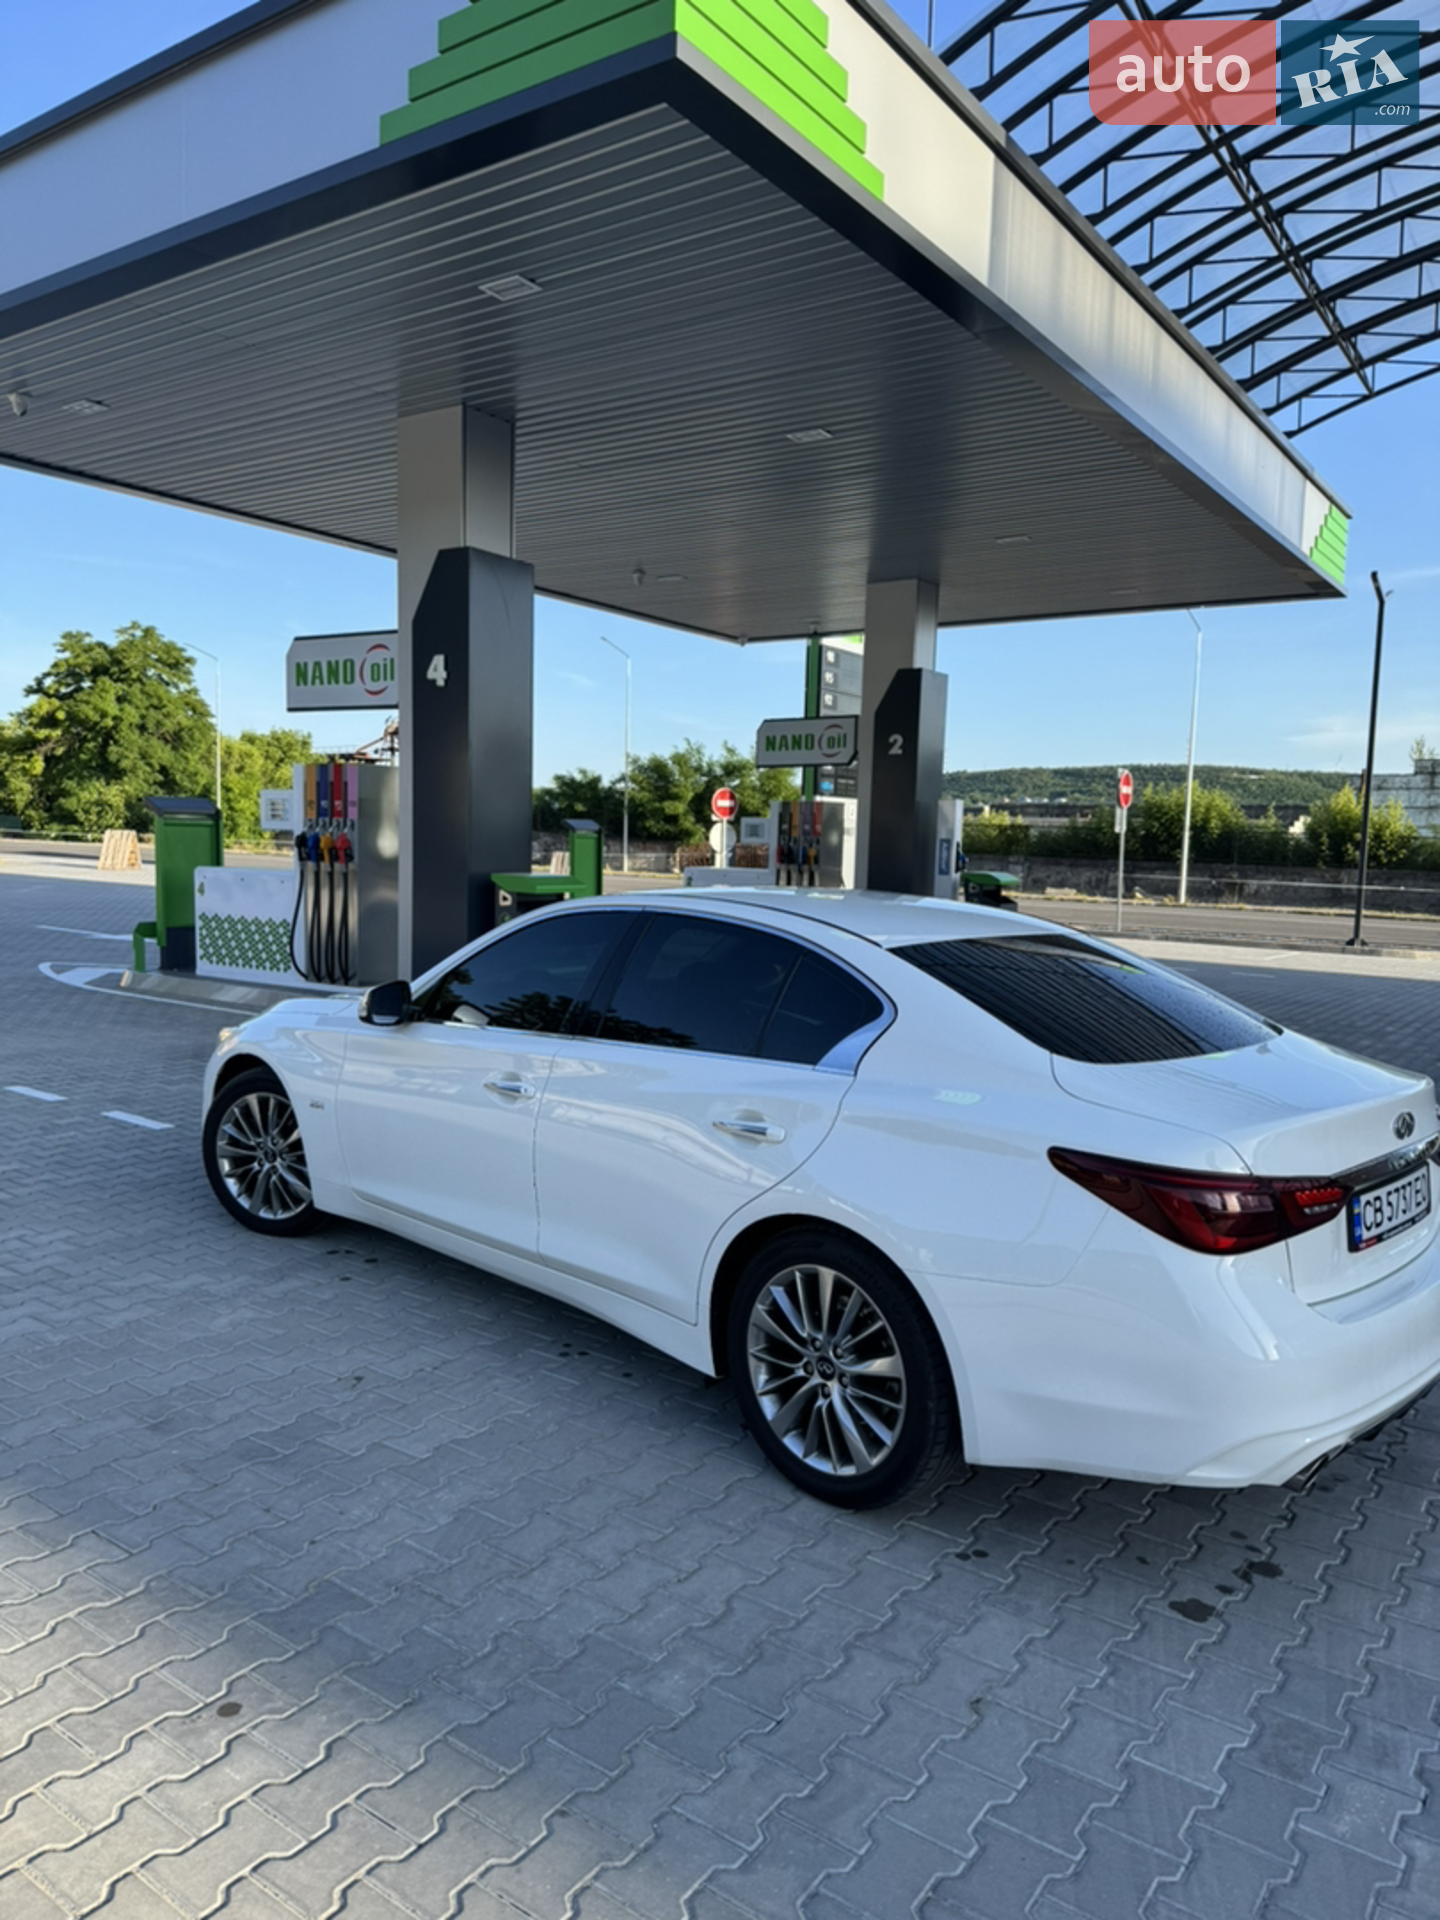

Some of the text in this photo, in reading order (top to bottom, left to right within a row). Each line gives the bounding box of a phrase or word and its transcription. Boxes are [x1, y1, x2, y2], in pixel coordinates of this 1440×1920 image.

[295, 657, 395, 687] NANO oil
[426, 654, 447, 687] 4
[765, 732, 847, 752] NANO oil
[888, 733, 904, 755] 2
[1363, 1196, 1384, 1231] CB
